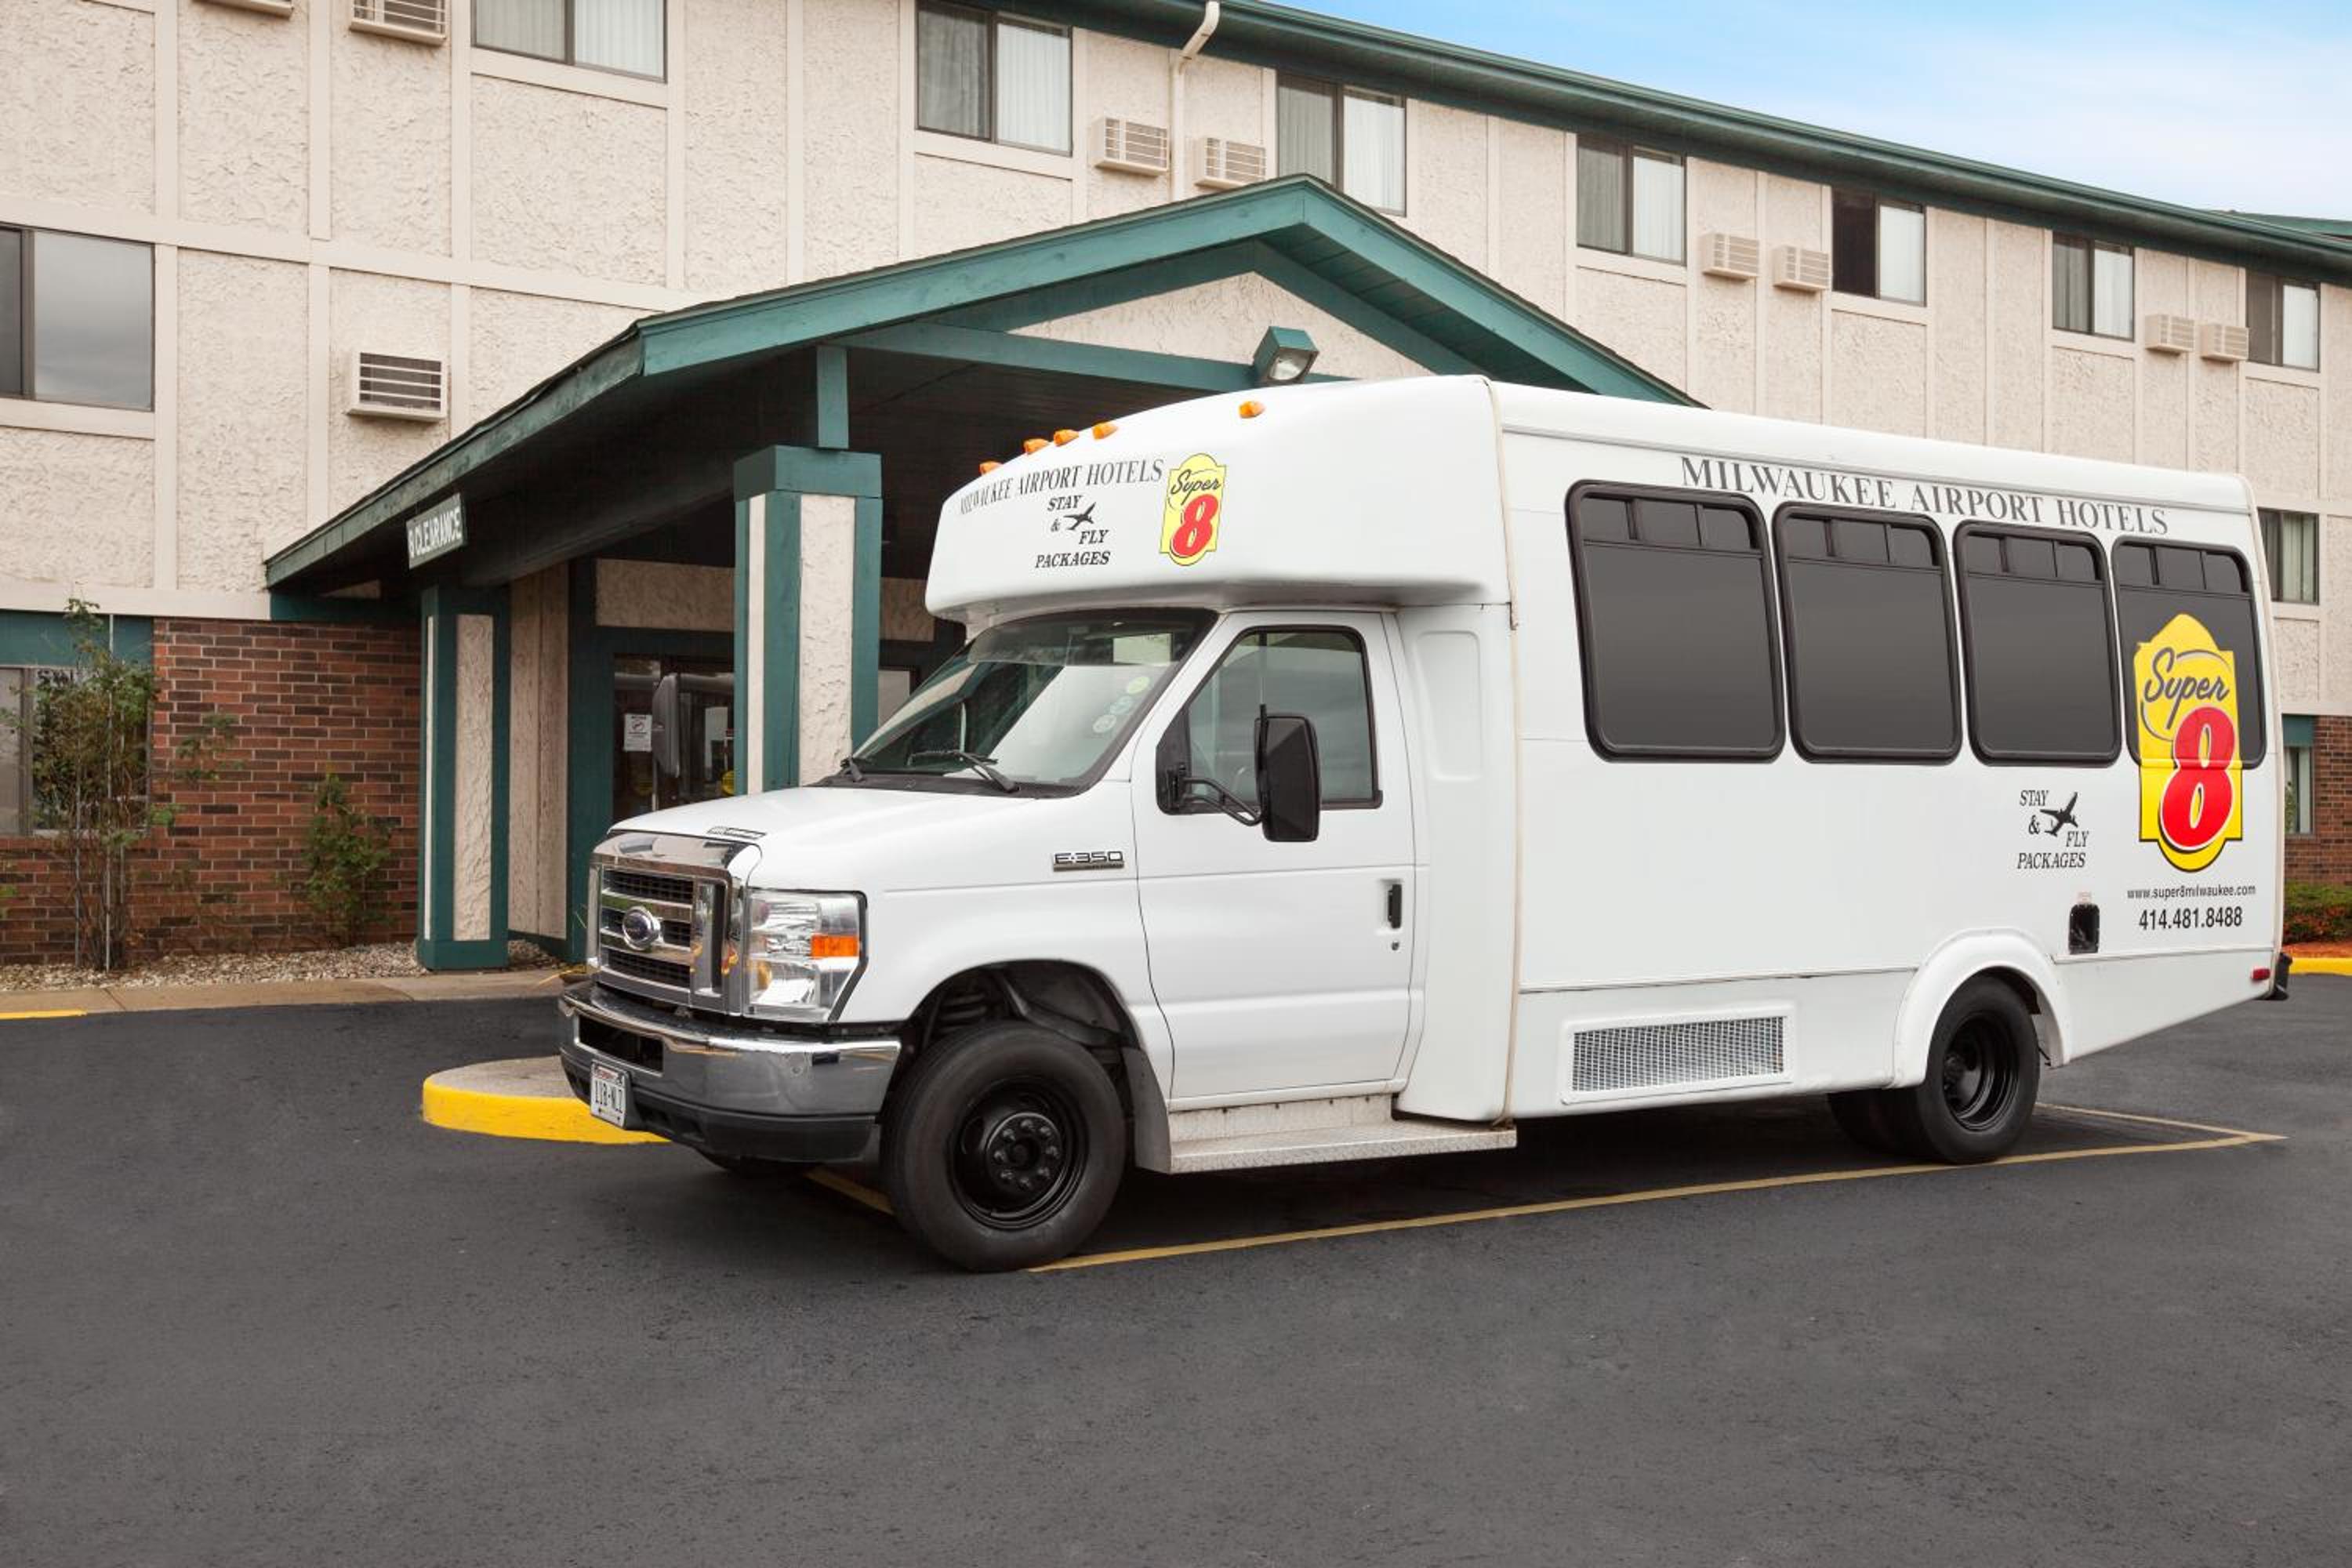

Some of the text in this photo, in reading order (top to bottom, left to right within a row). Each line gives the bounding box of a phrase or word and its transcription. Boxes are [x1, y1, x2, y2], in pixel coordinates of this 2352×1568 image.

[1018, 465, 1083, 495] AIRPORT
[1086, 459, 1164, 486] HOTELS
[1171, 469, 1221, 506] Super
[1681, 456, 2169, 535] MILWAUKEE AIRPORT HOTELS
[1047, 495, 1083, 512] STAY
[1051, 517, 1062, 532] &
[1170, 493, 1218, 558] 8
[1078, 529, 1110, 544] FLY
[1035, 550, 1111, 568] PACKAGES
[2143, 647, 2230, 730] Super
[2158, 706, 2236, 854] 8
[2020, 789, 2049, 807] STAY
[2028, 815, 2040, 835] &
[2066, 830, 2089, 848] FLY
[1054, 851, 1123, 865] E-350
[2017, 852, 2086, 869] PACKAGES
[2127, 884, 2256, 900] www.super8milwaukee.com
[2139, 906, 2243, 931] 414.481.8488
